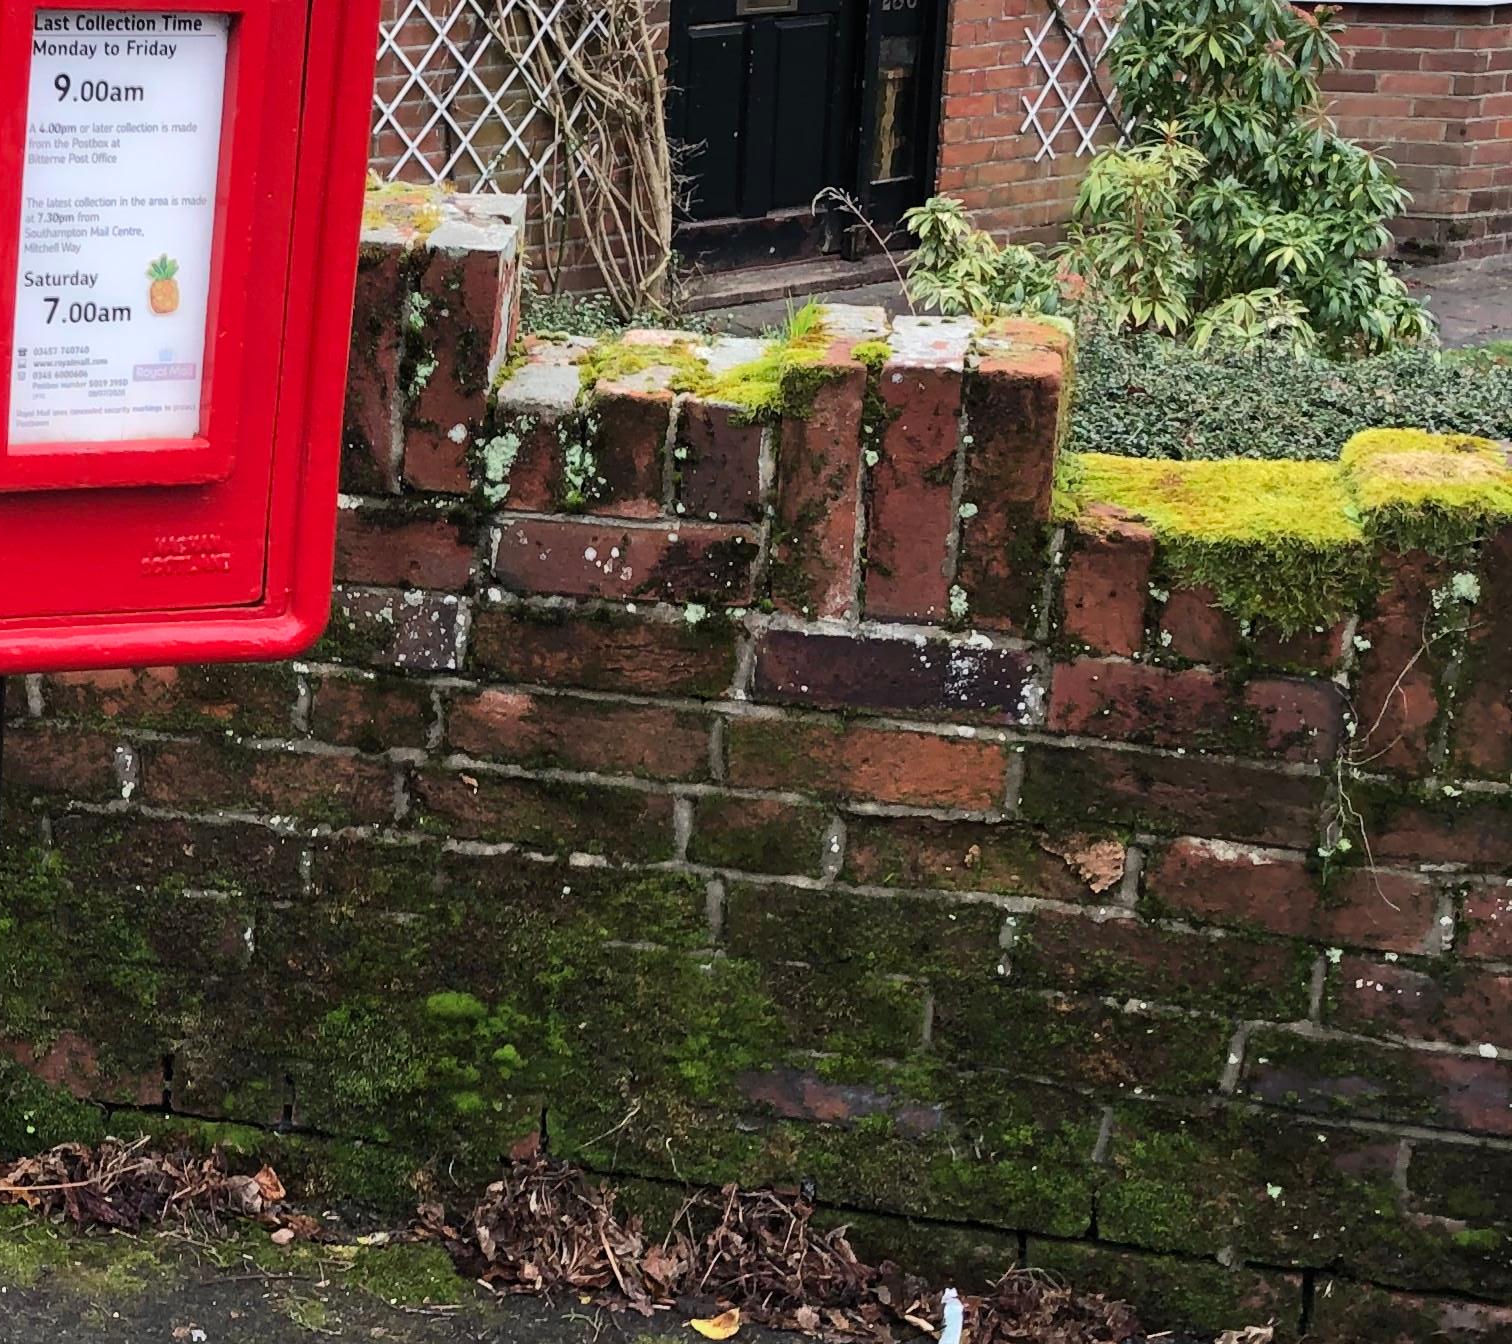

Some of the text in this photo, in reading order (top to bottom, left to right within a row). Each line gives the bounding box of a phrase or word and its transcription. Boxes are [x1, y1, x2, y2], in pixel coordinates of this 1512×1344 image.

[33, 13, 203, 32] Last Collection Time
[33, 40, 178, 59] Monday to Friday
[54, 73, 144, 102] 9.00am
[29, 122, 198, 135] A 4.00pm or later collection is made
[28, 138, 120, 150] from the Postbox at
[28, 153, 118, 165] Bitterne Post Office
[26, 195, 207, 208] The latest collection in the area is made
[25, 211, 100, 225] at 7.30pm from
[24, 227, 87, 240] Southampton
[89, 225, 109, 237] Mail
[23, 242, 82, 255] Mitchell Way
[24, 270, 98, 288] Saturday
[43, 297, 131, 324] 7.00am
